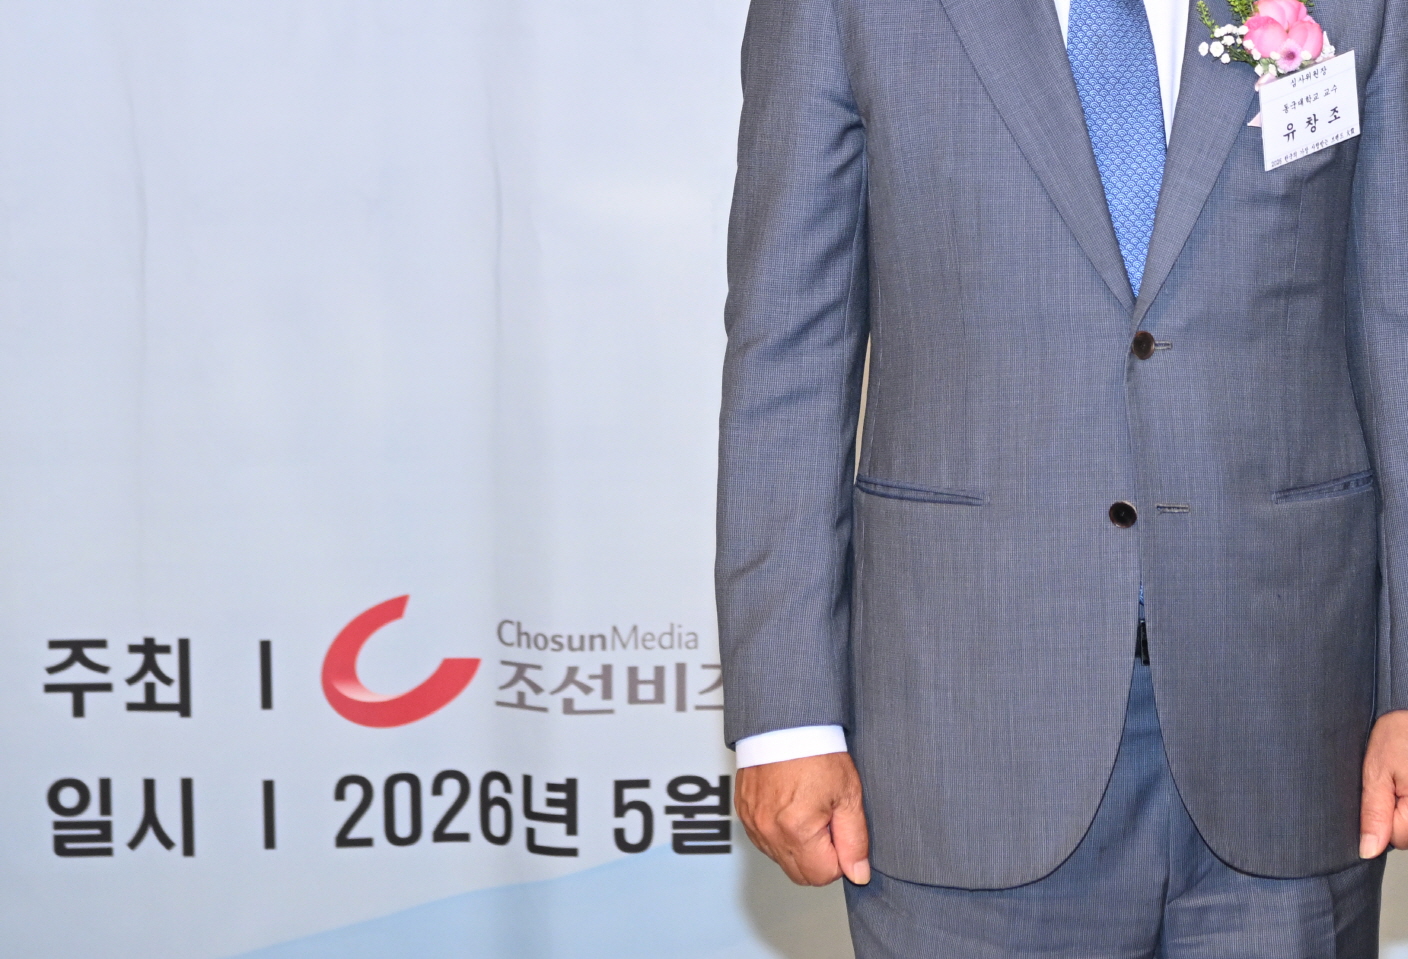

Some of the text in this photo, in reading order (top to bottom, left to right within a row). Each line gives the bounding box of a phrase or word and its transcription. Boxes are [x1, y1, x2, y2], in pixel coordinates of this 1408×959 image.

[1291, 66, 1327, 87] 심사위원장
[1283, 84, 1337, 114] 동국대학교 교수
[497, 619, 699, 652] ChosunMedia
[44, 637, 192, 718] 주최
[46, 777, 196, 857] 일시
[334, 769, 580, 857] 2026년
[612, 774, 733, 855] 5월
